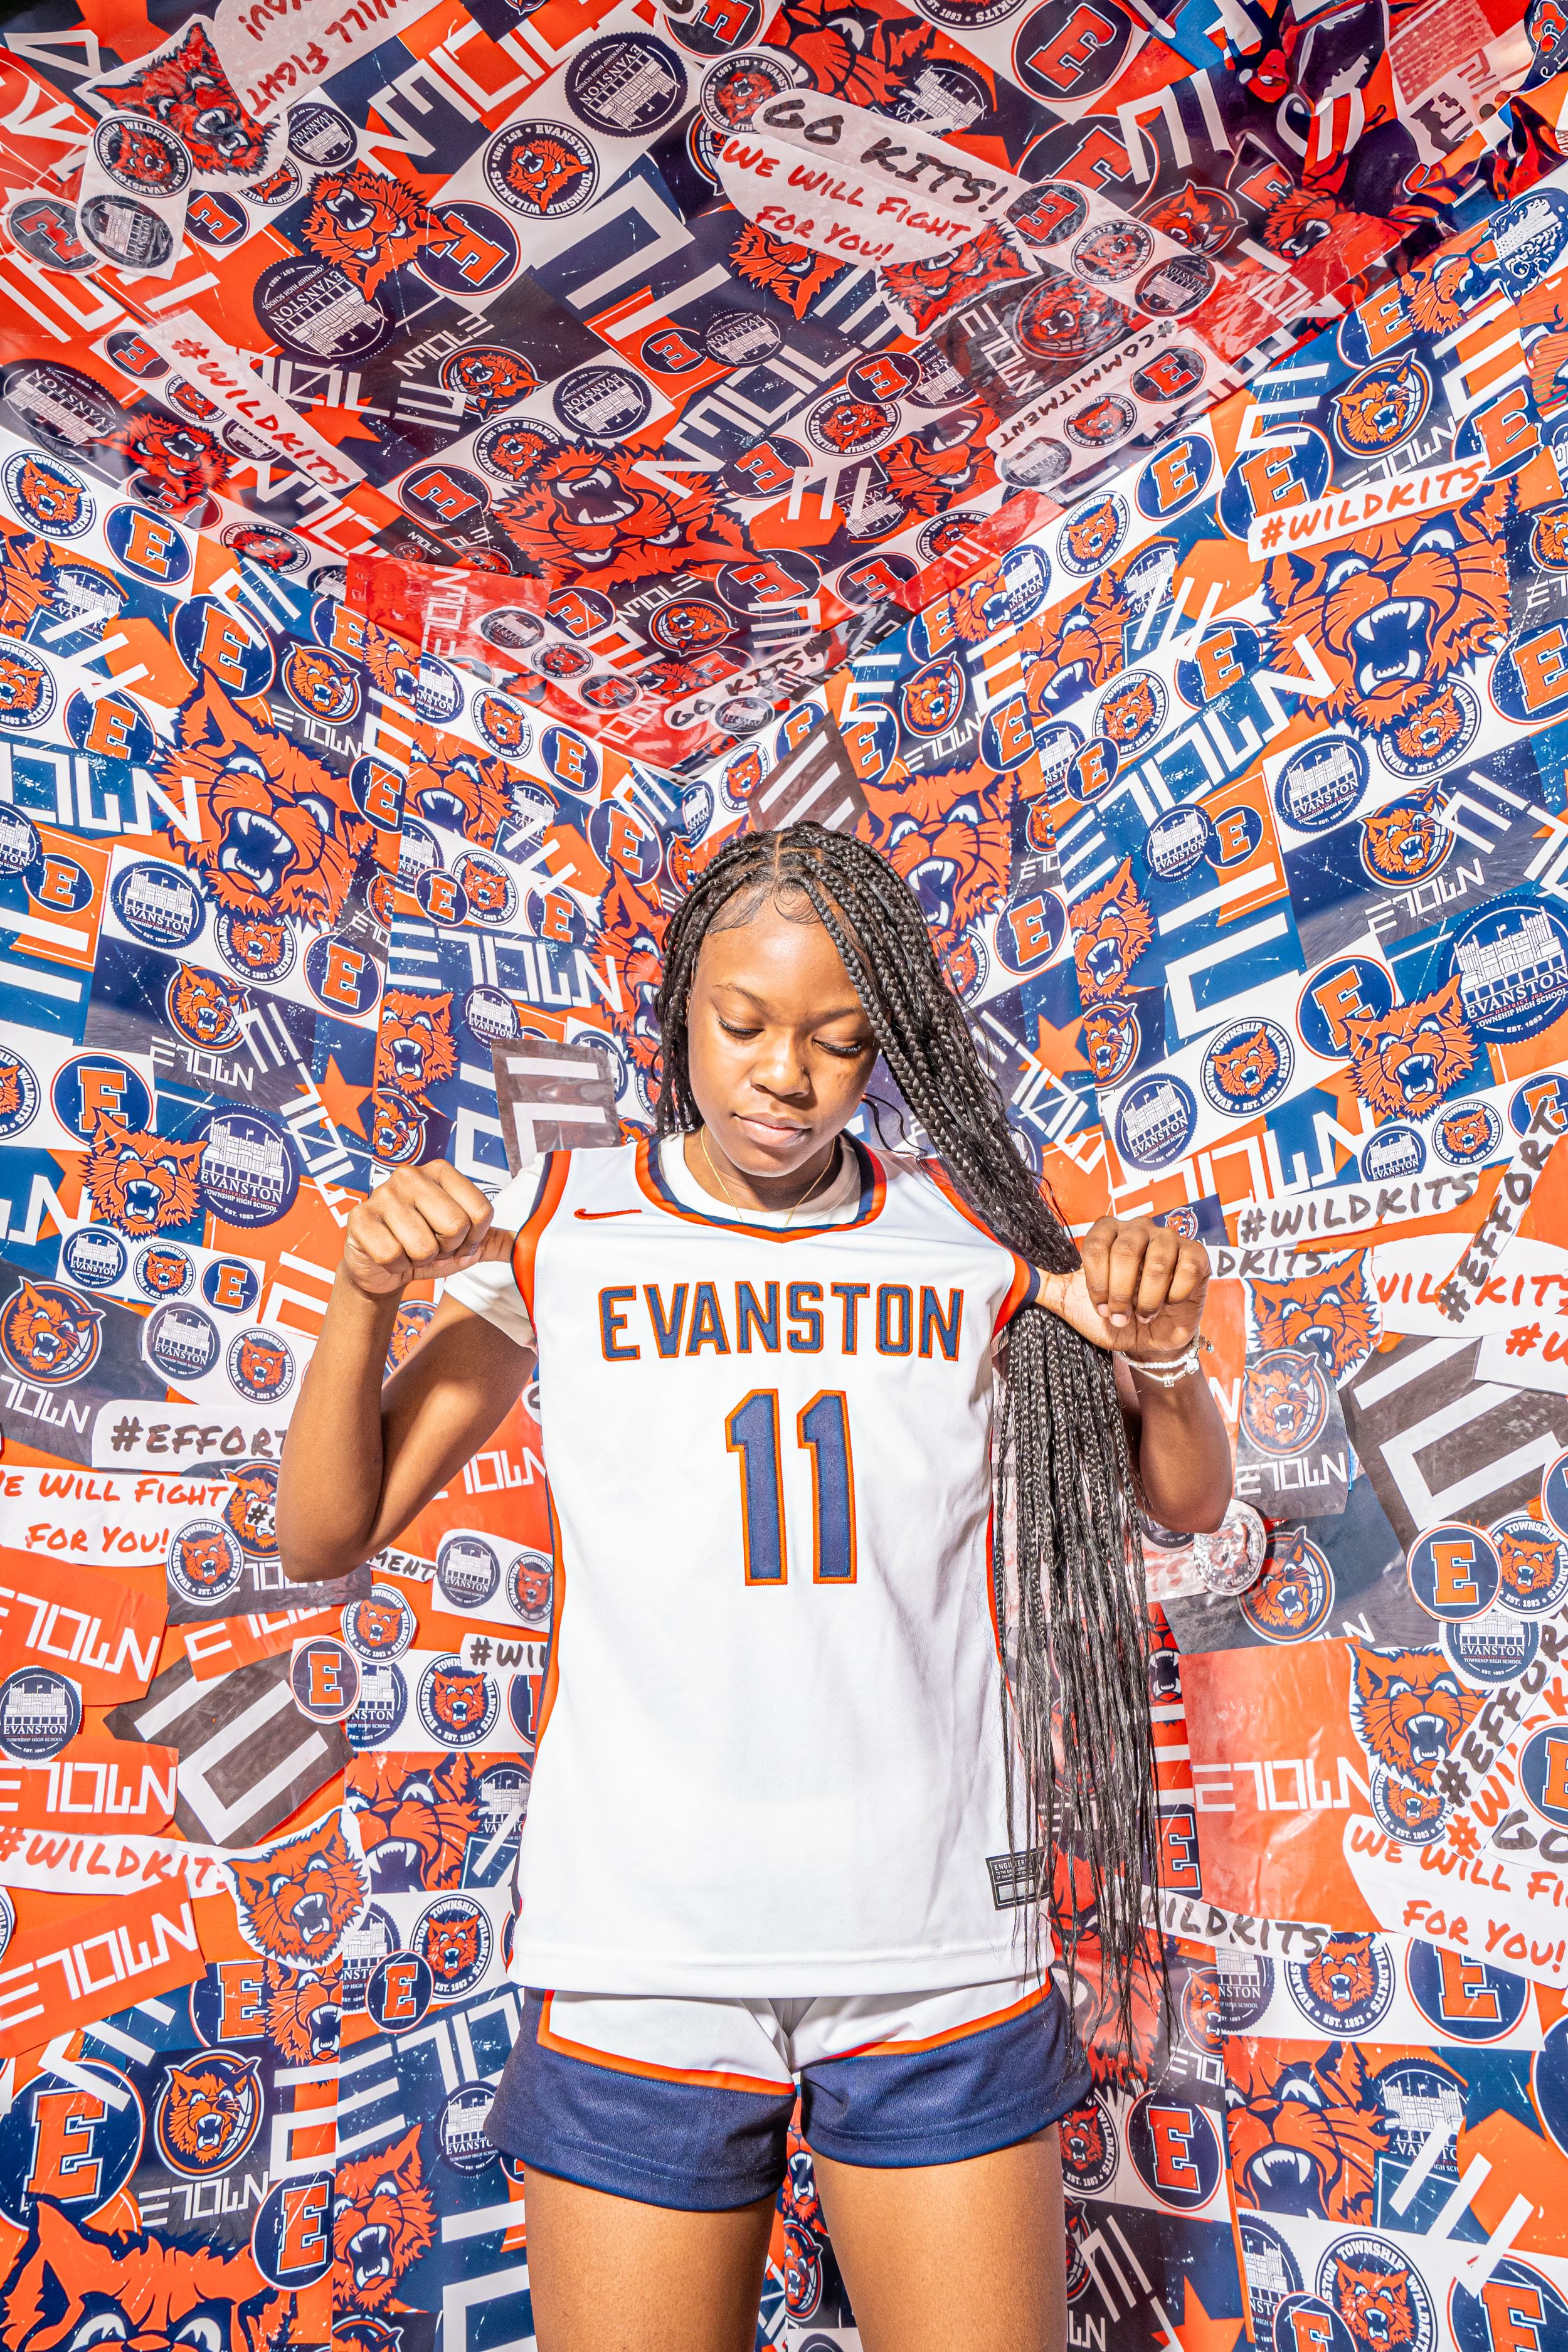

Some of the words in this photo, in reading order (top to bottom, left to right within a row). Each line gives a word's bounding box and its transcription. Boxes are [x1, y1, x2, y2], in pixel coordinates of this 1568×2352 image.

[579, 43, 644, 105] EVANSTON
[290, 111, 331, 144] EVANSTON
[535, 125, 591, 165] EVANSTON
[761, 98, 845, 146] GO
[860, 136, 1009, 213] KITS!
[490, 171, 541, 214] WILDKITS
[546, 171, 594, 214] TOWNSHIP
[723, 139, 774, 178] WE
[788, 164, 864, 208] WILL
[877, 196, 972, 243] FIGHT
[756, 205, 815, 240] FOR
[824, 222, 894, 262] YOU!
[268, 270, 346, 325] EVANSTON
[647, 331, 705, 371] E
[707, 315, 763, 346] EVANSTON
[29, 368, 117, 432] EVANSTON
[563, 373, 620, 412] EVANSTON
[859, 356, 912, 401] E
[998, 318, 1175, 449] #COMMITMENT
[171, 336, 350, 485] #WILDKITS
[810, 420, 842, 453] WILDKITS
[844, 421, 895, 453] TOWNSHIP
[7, 457, 28, 504] EVANSTON
[29, 454, 82, 489] TOWNSHIP
[68, 492, 95, 535] WILDKITS
[408, 469, 480, 520] E
[1260, 458, 1487, 551] #WILDKITS
[125, 510, 173, 578] E
[28, 675, 53, 723] WILDKITS
[1104, 674, 1146, 704] TOWNSHIP
[1148, 678, 1168, 725] WILDKITS
[1452, 684, 1475, 741] WILDKITS
[554, 730, 589, 788] E
[1076, 741, 1108, 798] E
[1416, 761, 1436, 773] EST.
[1436, 749, 1456, 766] 1883
[1293, 778, 1359, 820] EVANSTON
[1337, 792, 1359, 807] SCHOOL
[1217, 810, 1252, 862] E
[41, 858, 79, 908] E
[430, 875, 458, 922] E
[123, 904, 190, 935] EVANSTON
[1009, 897, 1053, 968] E
[275, 930, 296, 977] WILDKITS
[321, 940, 371, 1010] E
[1465, 967, 1568, 1019] EVANSTON
[1515, 1000, 1535, 1014] HIGH
[1535, 986, 1568, 1007] SCHOOL
[469, 1017, 511, 1038] EVANSTON
[1212, 1022, 1263, 1054] TOWNSHIP
[1506, 1024, 1525, 1034] EST.
[1525, 1014, 1544, 1027] 1883
[1264, 1024, 1291, 1079] WILDKITS
[16, 1069, 34, 1126] WILDKITS
[1205, 1060, 1231, 1110] EVANSTON
[1242, 1100, 1259, 1111] EST.
[1259, 1086, 1276, 1104] 1883
[1131, 1115, 1189, 1159] EVANSTON
[1444, 1104, 1484, 1126] TOWNSHIP
[1484, 1106, 1502, 1146] WILDKITS
[1436, 1121, 1453, 1162] EVANSTON
[200, 1170, 283, 1204] EVANSTON
[1374, 1158, 1419, 1179] EVANSTON
[224, 1207, 238, 1218] EST.
[238, 1212, 255, 1221] 1883
[234, 1197, 252, 1207] HIGH
[252, 1201, 278, 1214] SCHOOL
[1241, 1172, 1478, 1245] #WILDKITS
[1439, 1100, 1563, 1323] #EFFORT
[71, 1260, 117, 1277] EVANSTON
[149, 1244, 188, 1263] TOWNSHIP
[1218, 1248, 1322, 1278] DKITS
[217, 1264, 251, 1308] E
[598, 1281, 964, 1362] EVANSTON
[154, 1342, 208, 1367] EVANSTON
[231, 1340, 246, 1383] EVANSTON
[245, 1332, 286, 1351] TOWNSHIP
[275, 1350, 294, 1395] WILDKITS
[38, 1473, 120, 1502] WILL
[134, 1478, 228, 1507] FIGHT
[724, 1388, 857, 1586] 11
[1235, 1451, 1348, 1496] ETOWN
[25, 1523, 88, 1552] FOR
[103, 1525, 169, 1554] YOU!
[181, 1522, 221, 1540] TOWNSHIP
[172, 1542, 192, 1591] EVANSTON
[223, 1537, 241, 1581] WILDKITS
[1430, 1539, 1480, 1607] E
[1507, 1520, 1558, 1544] TOWNSHIP
[1546, 1545, 1568, 1600] WILDKITS
[198, 1587, 212, 1595] EST.
[212, 1582, 226, 1594] 1883
[445, 1576, 489, 1594] EVANSTON
[1505, 1594, 1522, 1607] EST.
[1523, 1597, 1540, 1608] 1883
[359, 1646, 373, 1656] EST.
[1459, 1644, 1525, 1656] EVANSTON
[308, 1651, 344, 1706] E
[421, 1671, 438, 1735] EVANSTON
[480, 1671, 499, 1732] WILDKITS
[3, 1724, 67, 1735] EVANSTON
[443, 1731, 458, 1744] EST.
[459, 1730, 476, 1743] 1883
[1395, 1826, 1412, 1838] EST.
[1412, 1828, 1431, 1840] 1883
[0, 1826, 225, 1890] #WILDKIT
[1348, 1823, 1404, 1864] WE
[1418, 1843, 1512, 1892] WILL
[429, 1898, 480, 1920] TOWNSHIP
[471, 1919, 492, 1978] WILDKITS
[1402, 1899, 1469, 1945] FOR
[1484, 1919, 1567, 1973] YOU!
[434, 1981, 450, 1993] EST.
[450, 1978, 468, 1993] 1883
[1322, 2015, 1343, 2028] EST.
[1344, 2014, 1365, 2029] 1883
[20, 2086, 109, 2213] E
[1097, 2111, 1114, 2177] WILDKITS
[1147, 2104, 1201, 2195] E
[137, 2169, 270, 2227] ETOWN
[1083, 2175, 1099, 2188] 1883
[276, 2180, 331, 2276] E
[1337, 2240, 1406, 2273] TOWNSHIP
